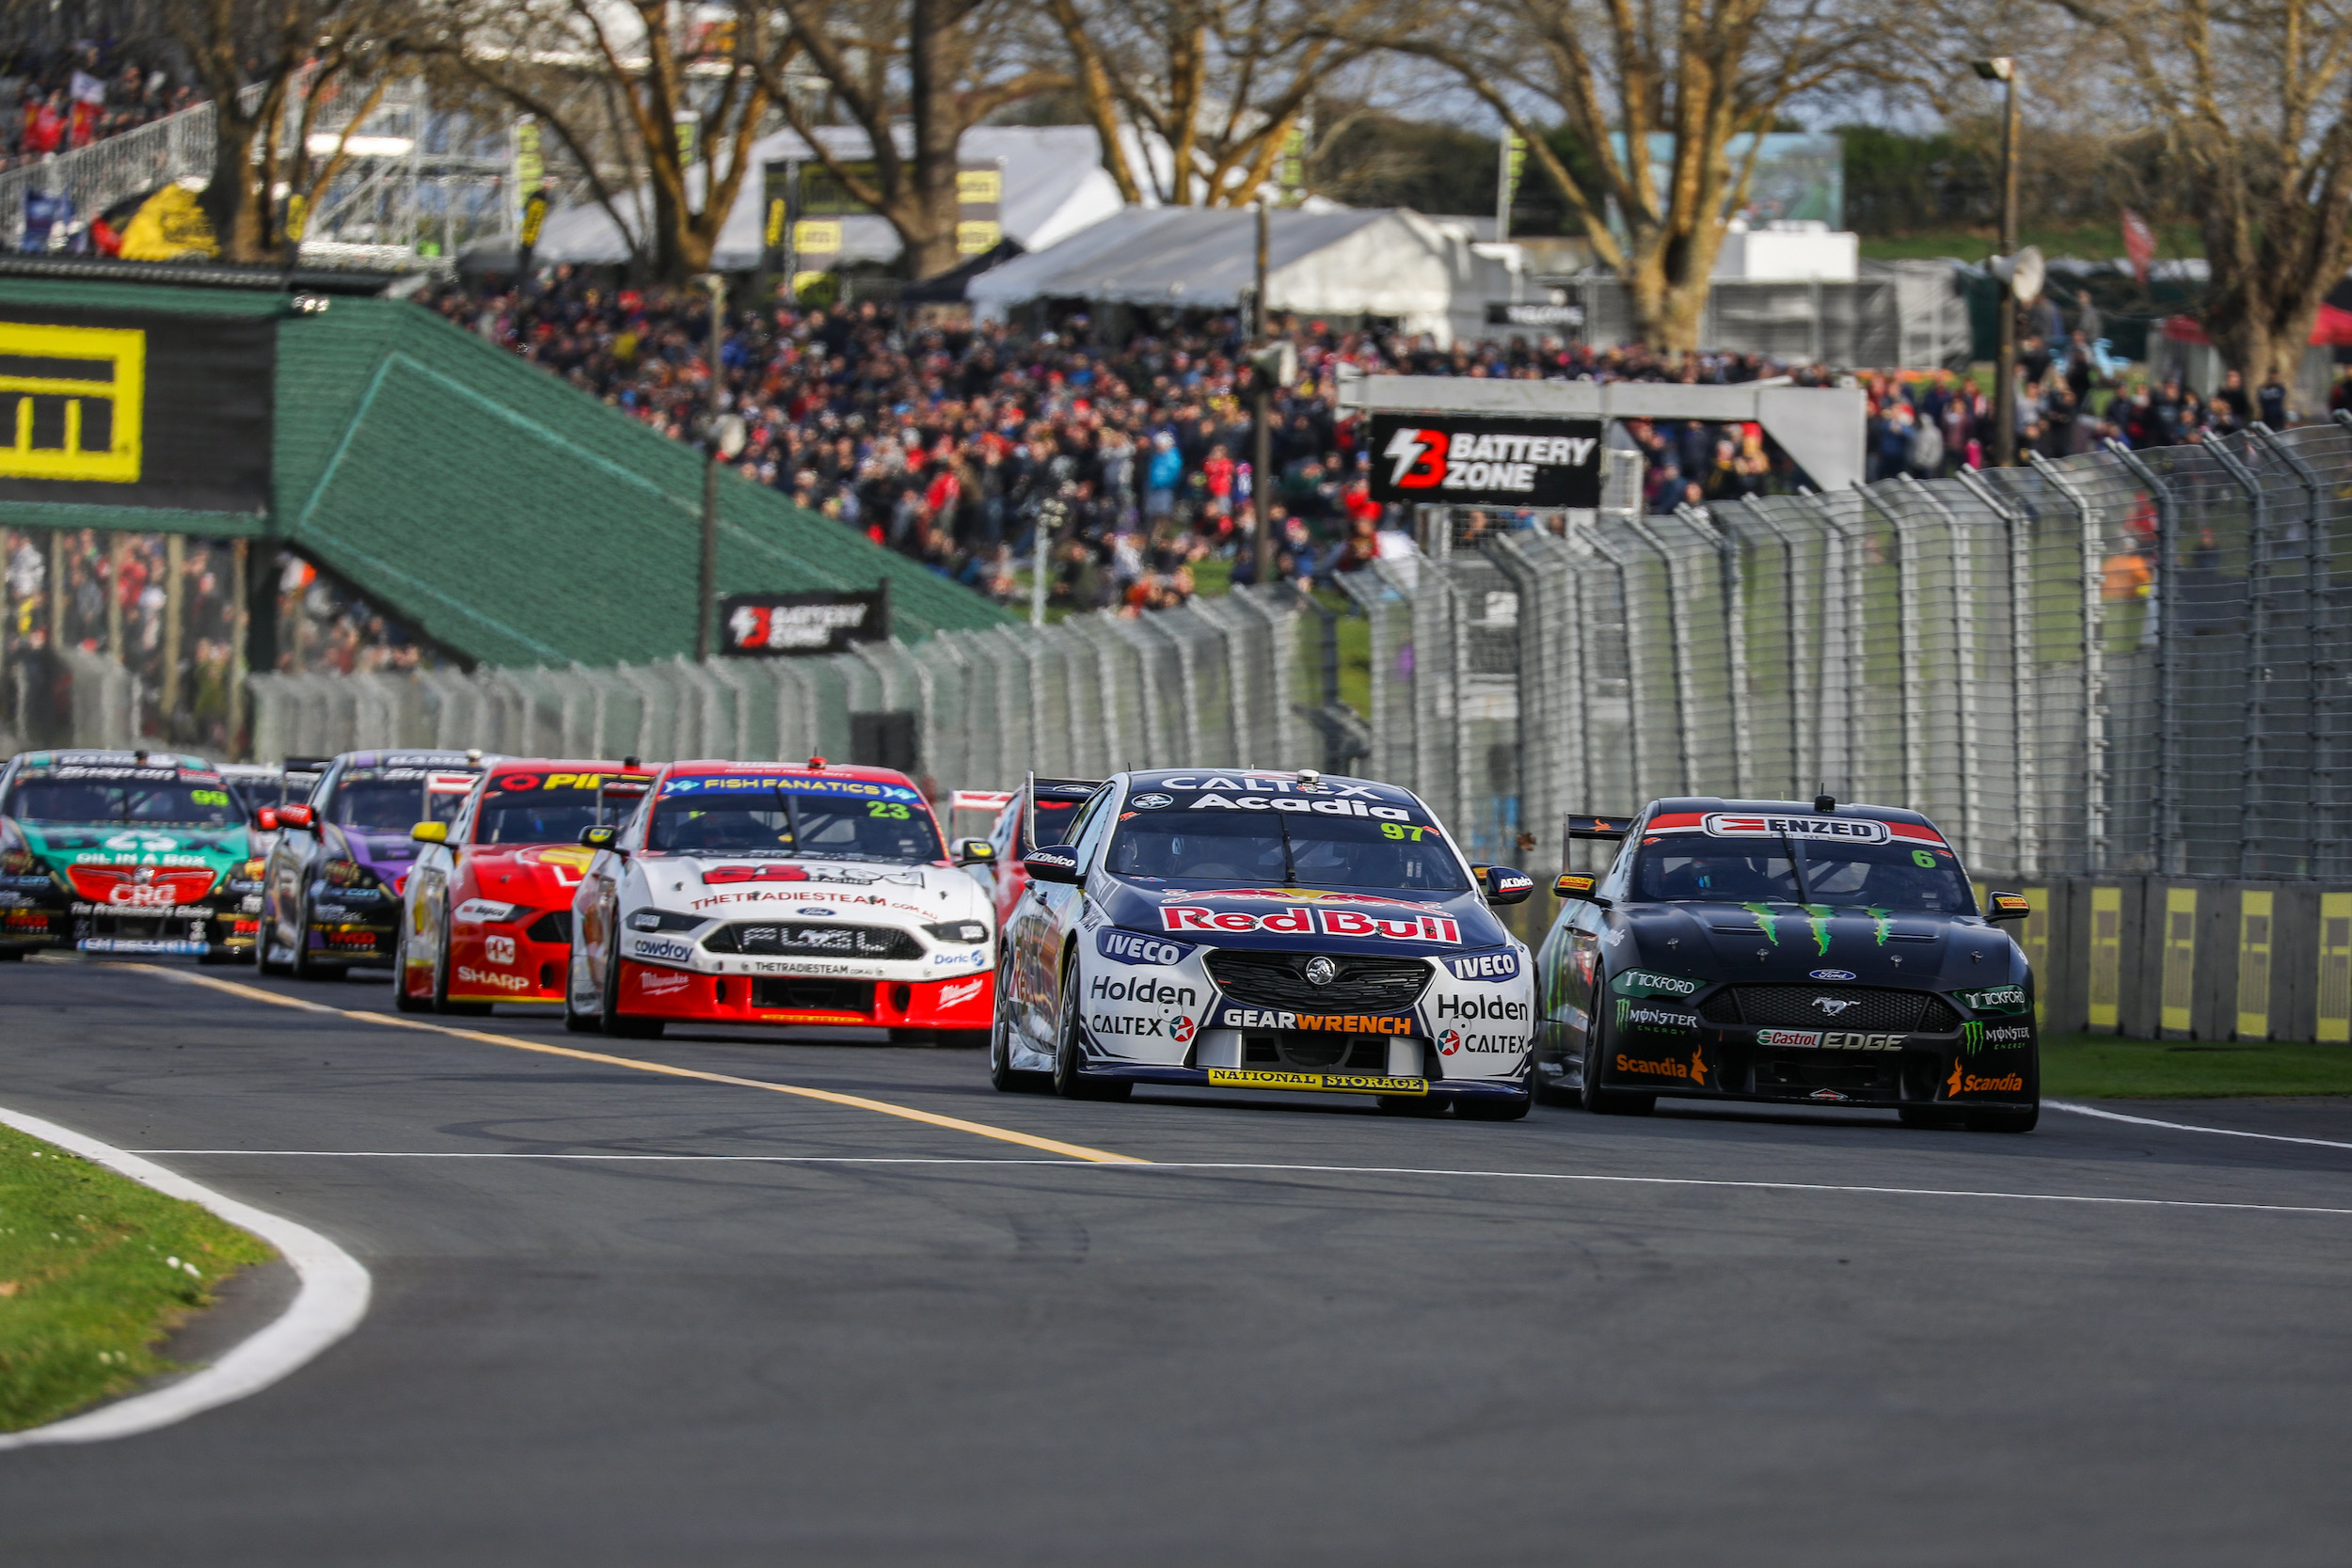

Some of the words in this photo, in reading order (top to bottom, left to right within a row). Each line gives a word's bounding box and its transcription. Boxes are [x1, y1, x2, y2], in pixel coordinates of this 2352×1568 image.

[1448, 433, 1597, 466] BATTERY
[1441, 461, 1537, 491] ZONE
[705, 779, 760, 789] FISH
[762, 779, 880, 796] FANATICS
[1161, 777, 1384, 800] CALTEX
[191, 789, 230, 807] 99
[1188, 793, 1410, 821] Acadia
[866, 800, 911, 819] 23
[1379, 822, 1423, 842] 97
[1768, 818, 1872, 837] ENZED
[116, 853, 137, 863] IN
[141, 852, 158, 863] A
[1026, 851, 1075, 867] ACDelco
[1912, 849, 1936, 868] 6
[1159, 907, 1315, 934] Red
[1318, 909, 1462, 944] Bull
[635, 940, 693, 961] cowdroy
[934, 954, 969, 965] Doric
[1105, 934, 1179, 965] IVECO
[1454, 954, 1515, 979] IVECO
[458, 966, 530, 990] SHARP
[1638, 973, 1694, 994] TICKFORD
[1090, 975, 1196, 1006] Holden
[1981, 990, 2026, 1006] TICKFORD
[1438, 993, 1528, 1022] Holden
[1092, 1015, 1163, 1037] CALTEX
[1223, 1008, 1411, 1035] GEARWRENCH
[1629, 1008, 1697, 1028] MONSTER
[1638, 1026, 1686, 1035] ENERGY
[1985, 1026, 2030, 1040] MONSTER
[1465, 1034, 1525, 1053] CALTEX
[1772, 1032, 1818, 1046] Castrol
[1820, 1032, 1908, 1052] EDGE
[1616, 1053, 1687, 1078] Scandia
[1213, 1070, 1316, 1085] NATIONAL
[1327, 1076, 1421, 1090] STORAGE
[1963, 1072, 2023, 1092] Scandia
